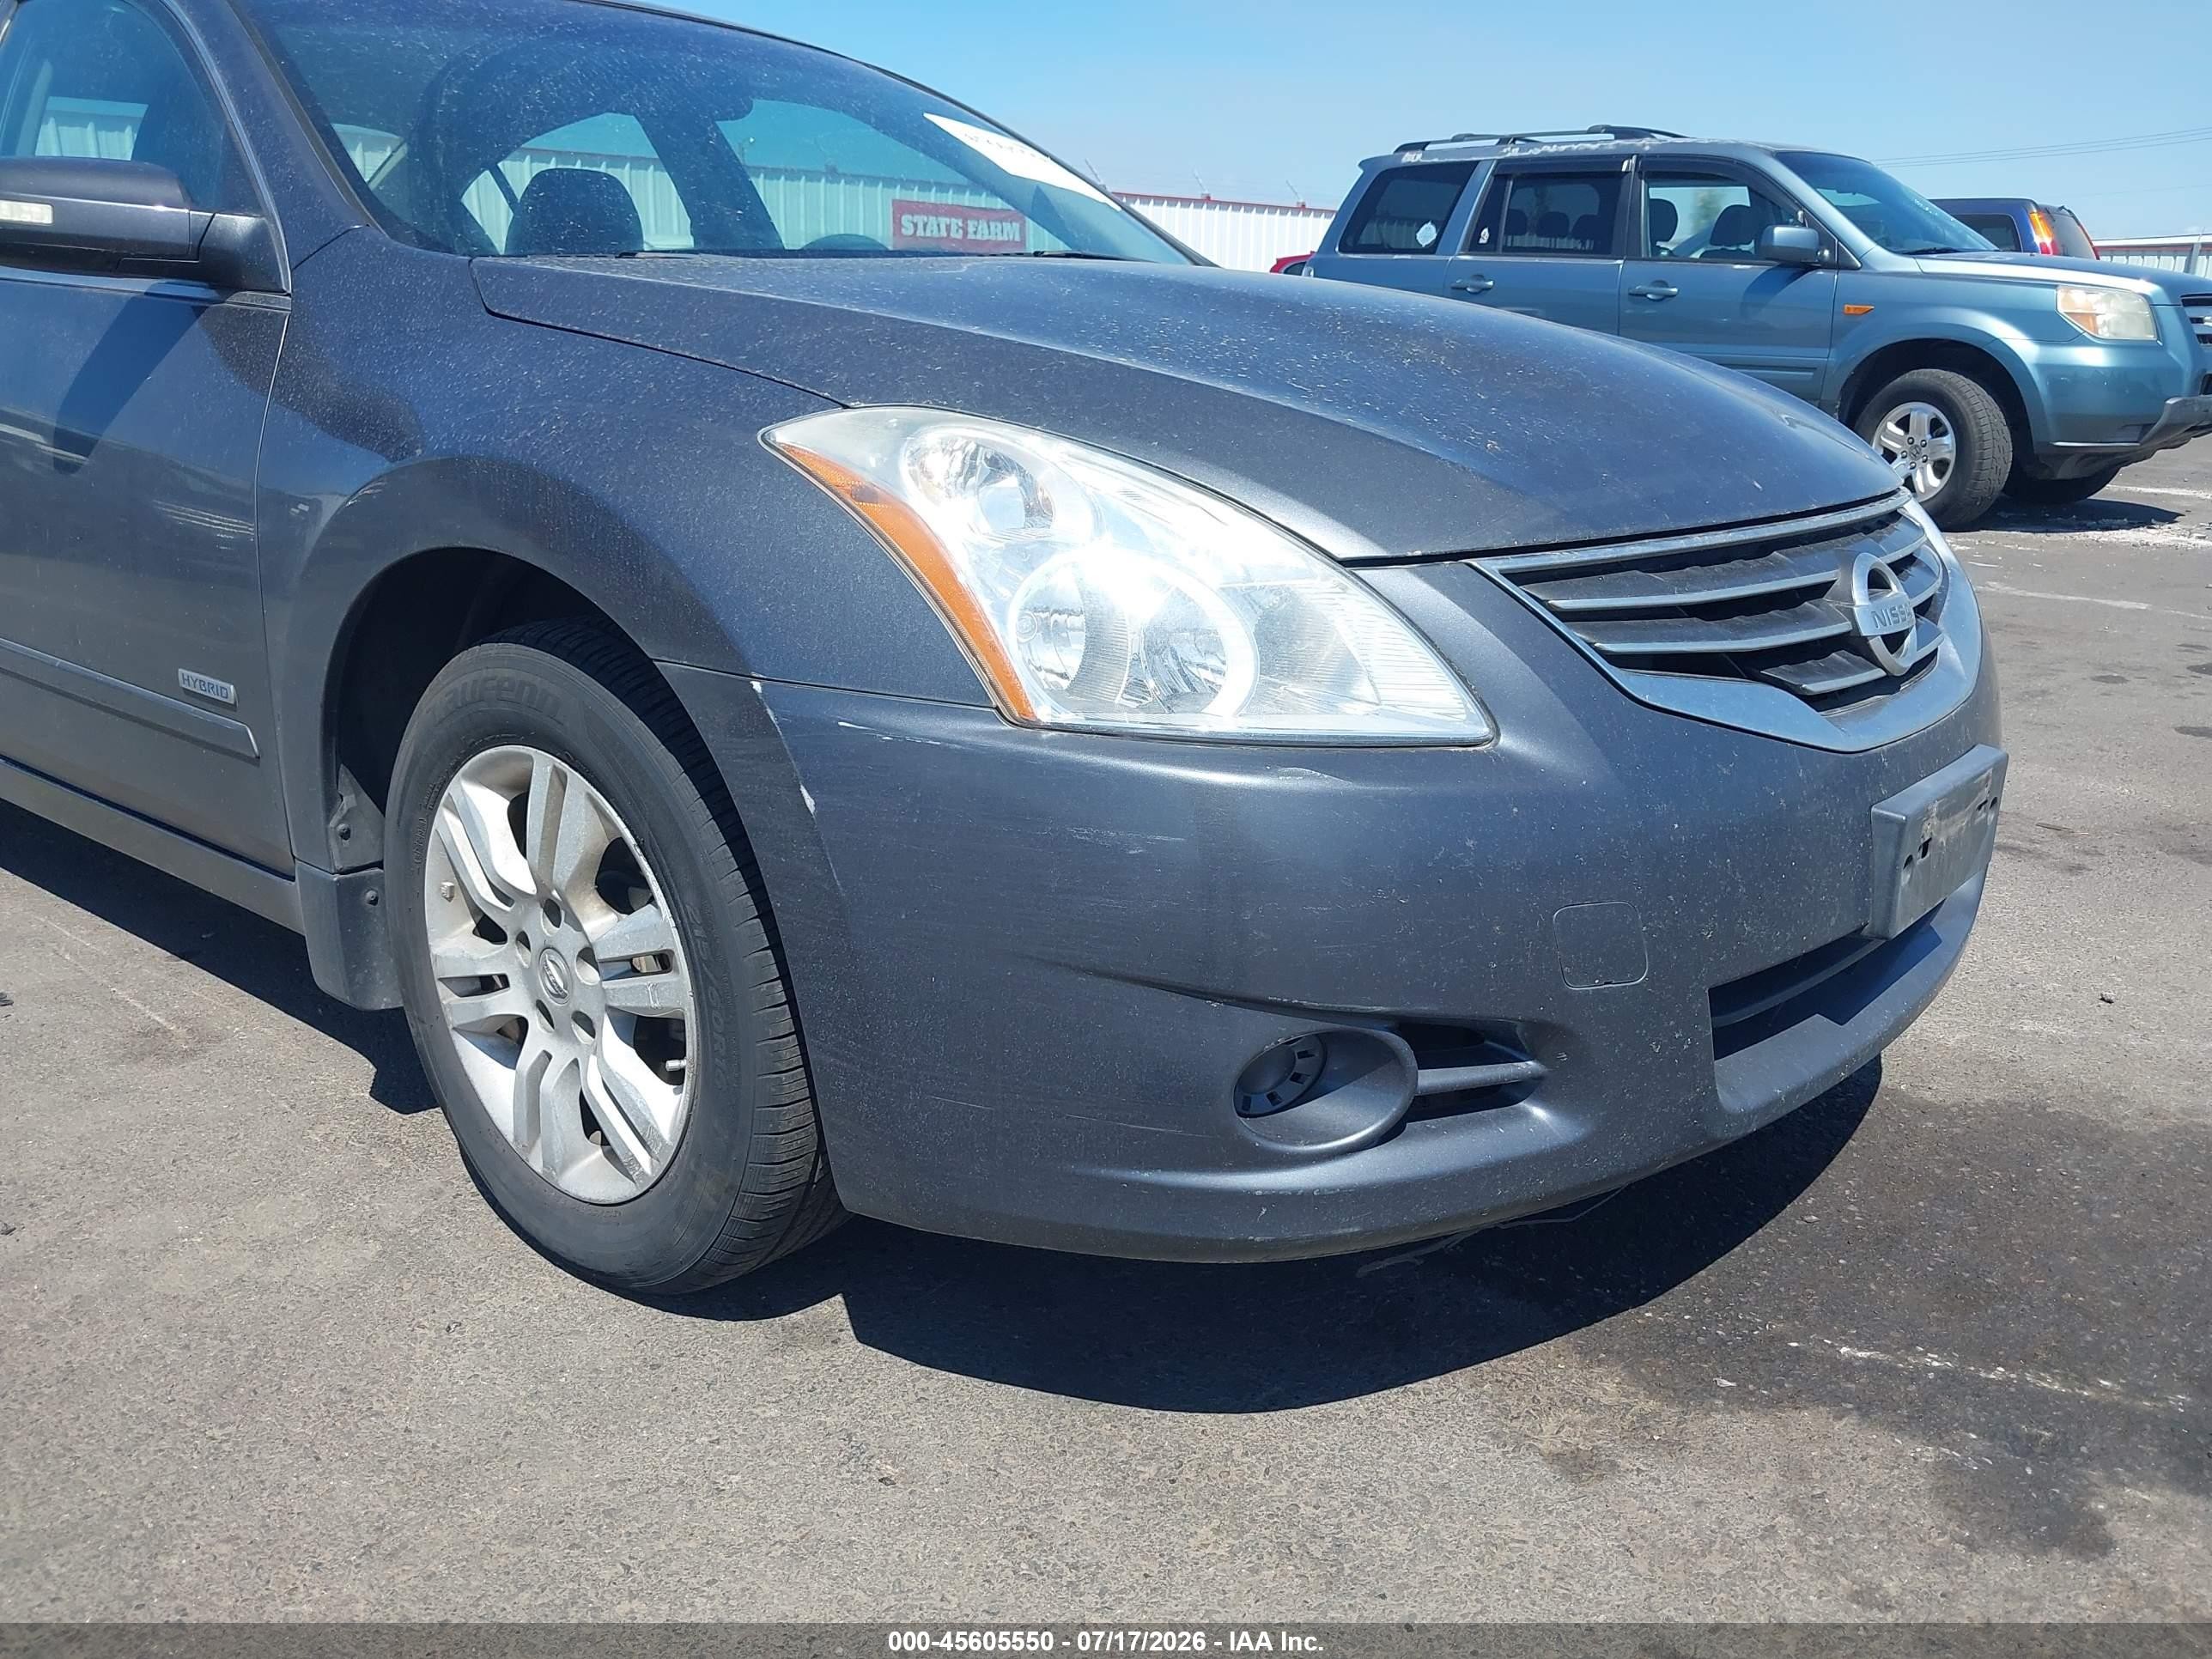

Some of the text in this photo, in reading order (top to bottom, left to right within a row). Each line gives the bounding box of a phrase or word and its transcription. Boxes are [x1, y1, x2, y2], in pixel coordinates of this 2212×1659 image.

[902, 215, 1021, 242] STATE FARM
[181, 672, 229, 700] HYBRID
